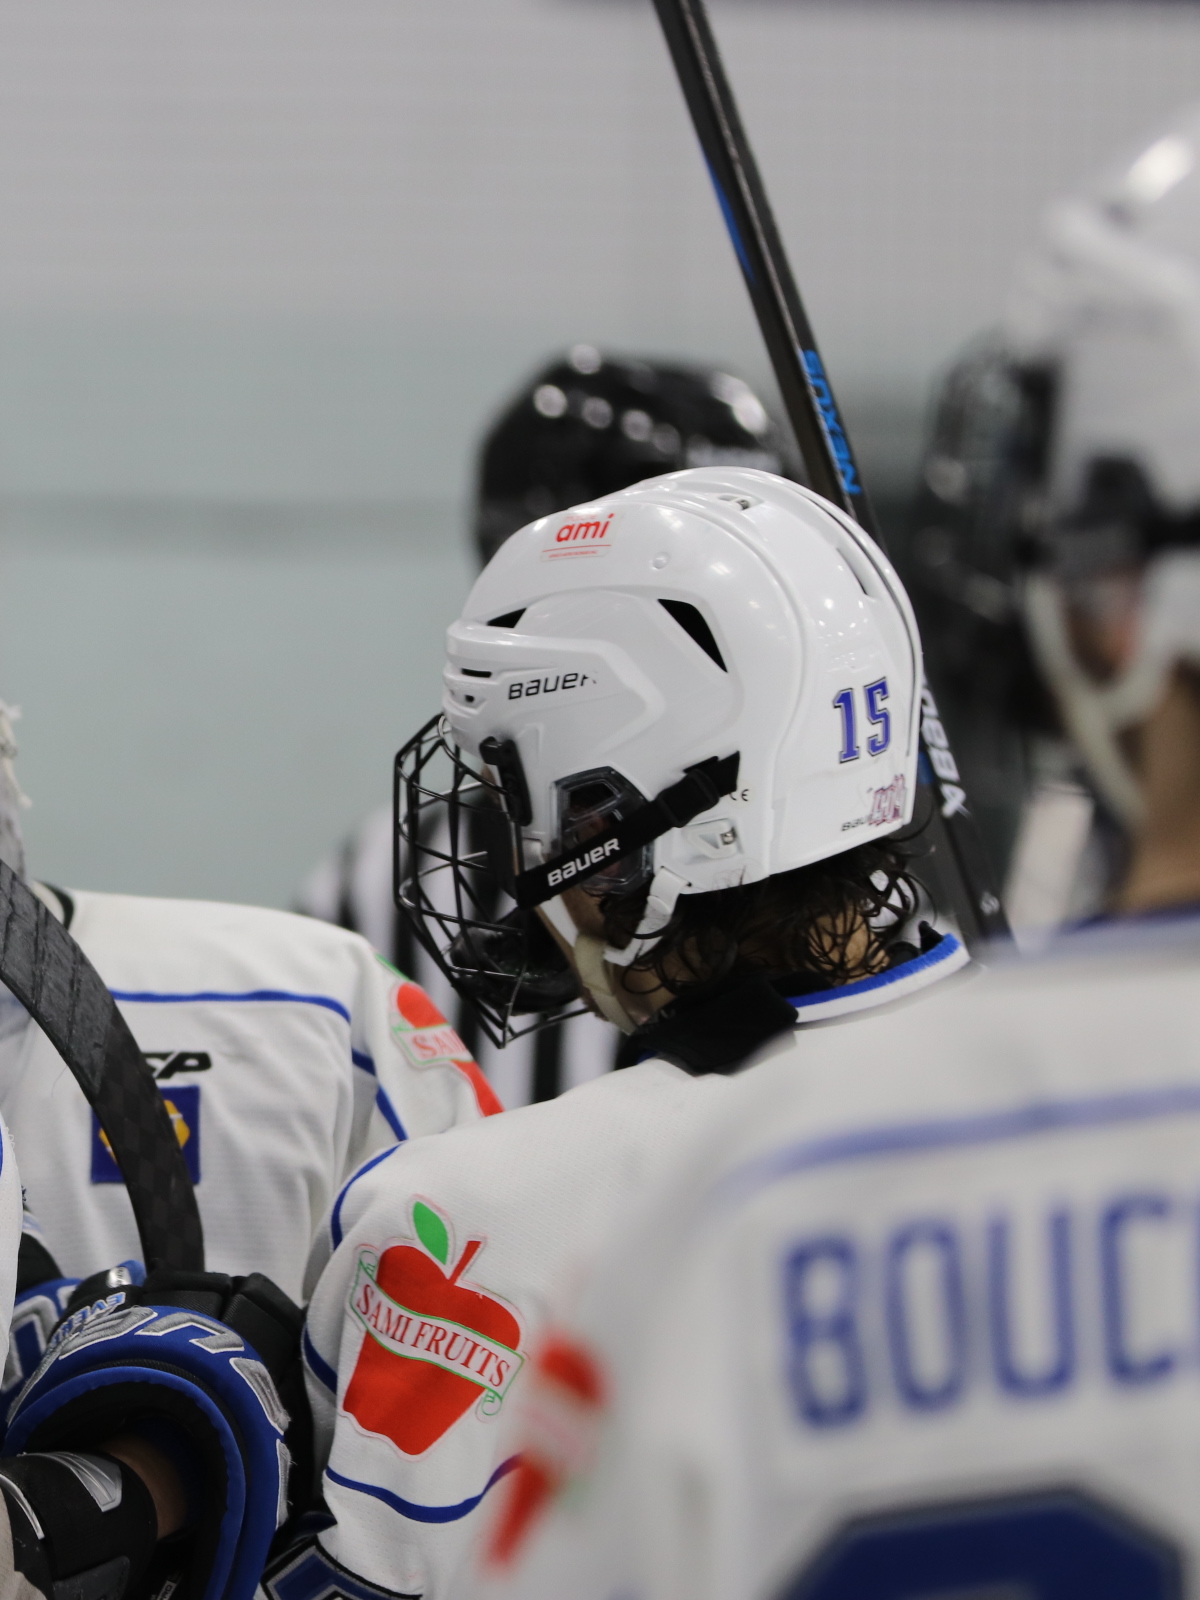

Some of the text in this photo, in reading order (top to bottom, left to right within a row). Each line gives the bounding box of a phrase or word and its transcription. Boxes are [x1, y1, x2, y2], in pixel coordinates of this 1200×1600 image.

[555, 513, 615, 542] ami
[833, 677, 891, 764] 15
[547, 838, 620, 887] BAUER
[356, 1283, 510, 1387] SAMI FRUITS
[782, 1192, 1200, 1430] BOUC
